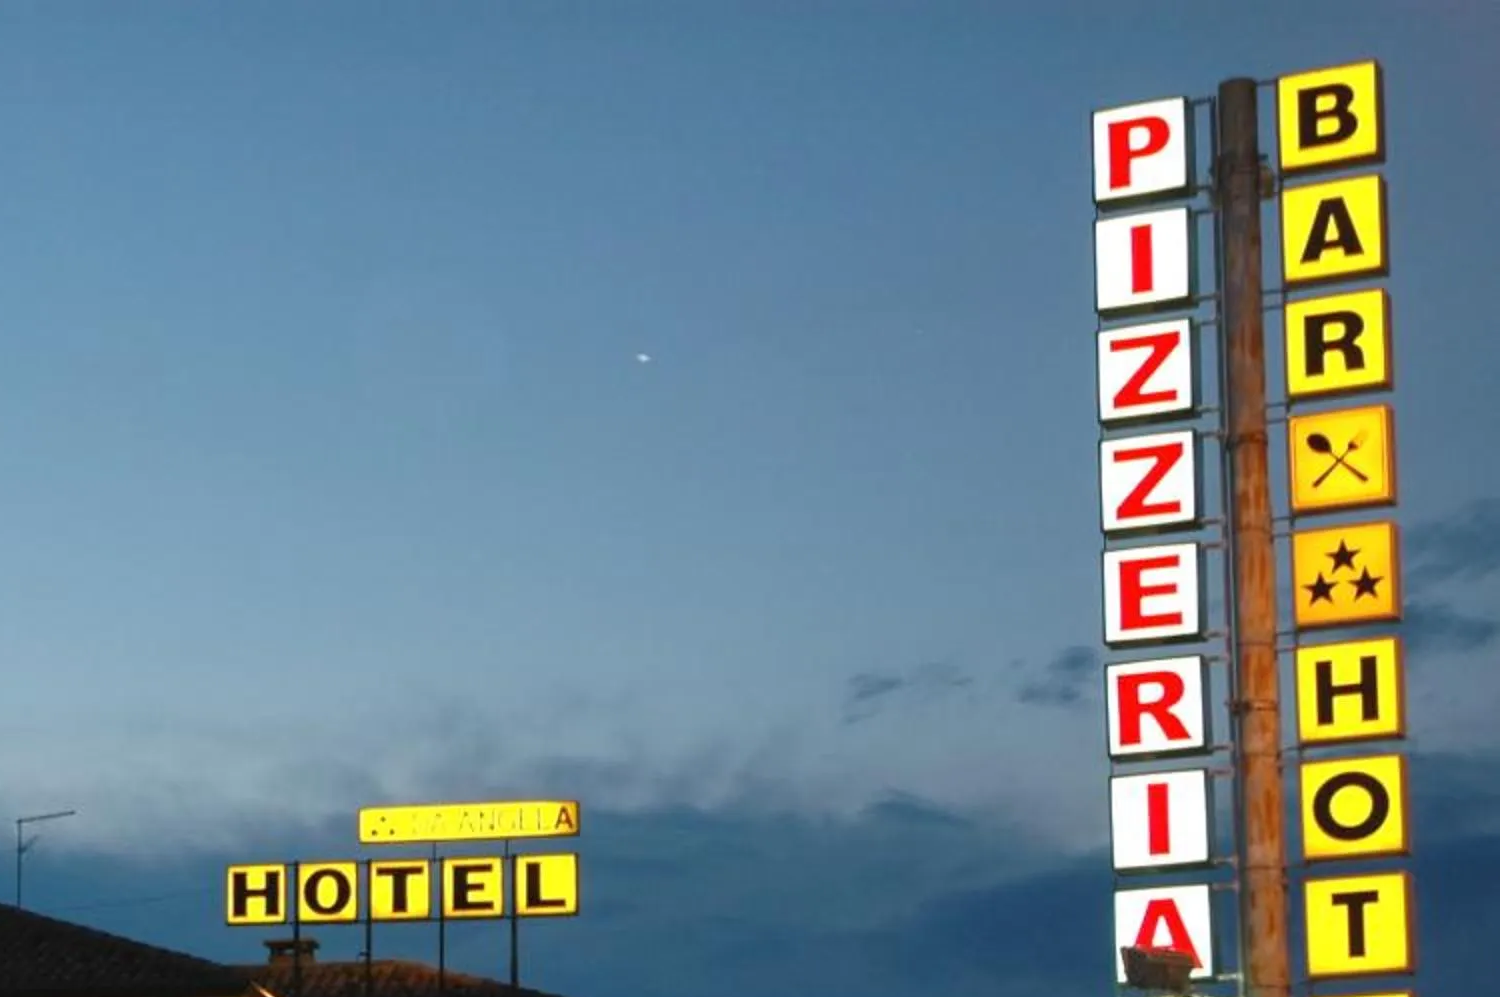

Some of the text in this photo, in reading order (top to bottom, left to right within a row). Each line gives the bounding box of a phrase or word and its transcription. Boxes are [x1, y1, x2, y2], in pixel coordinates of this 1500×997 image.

[1297, 83, 1365, 378] BAR
[1108, 115, 1203, 968] PIZZERIA
[232, 862, 566, 917] HOTEL
